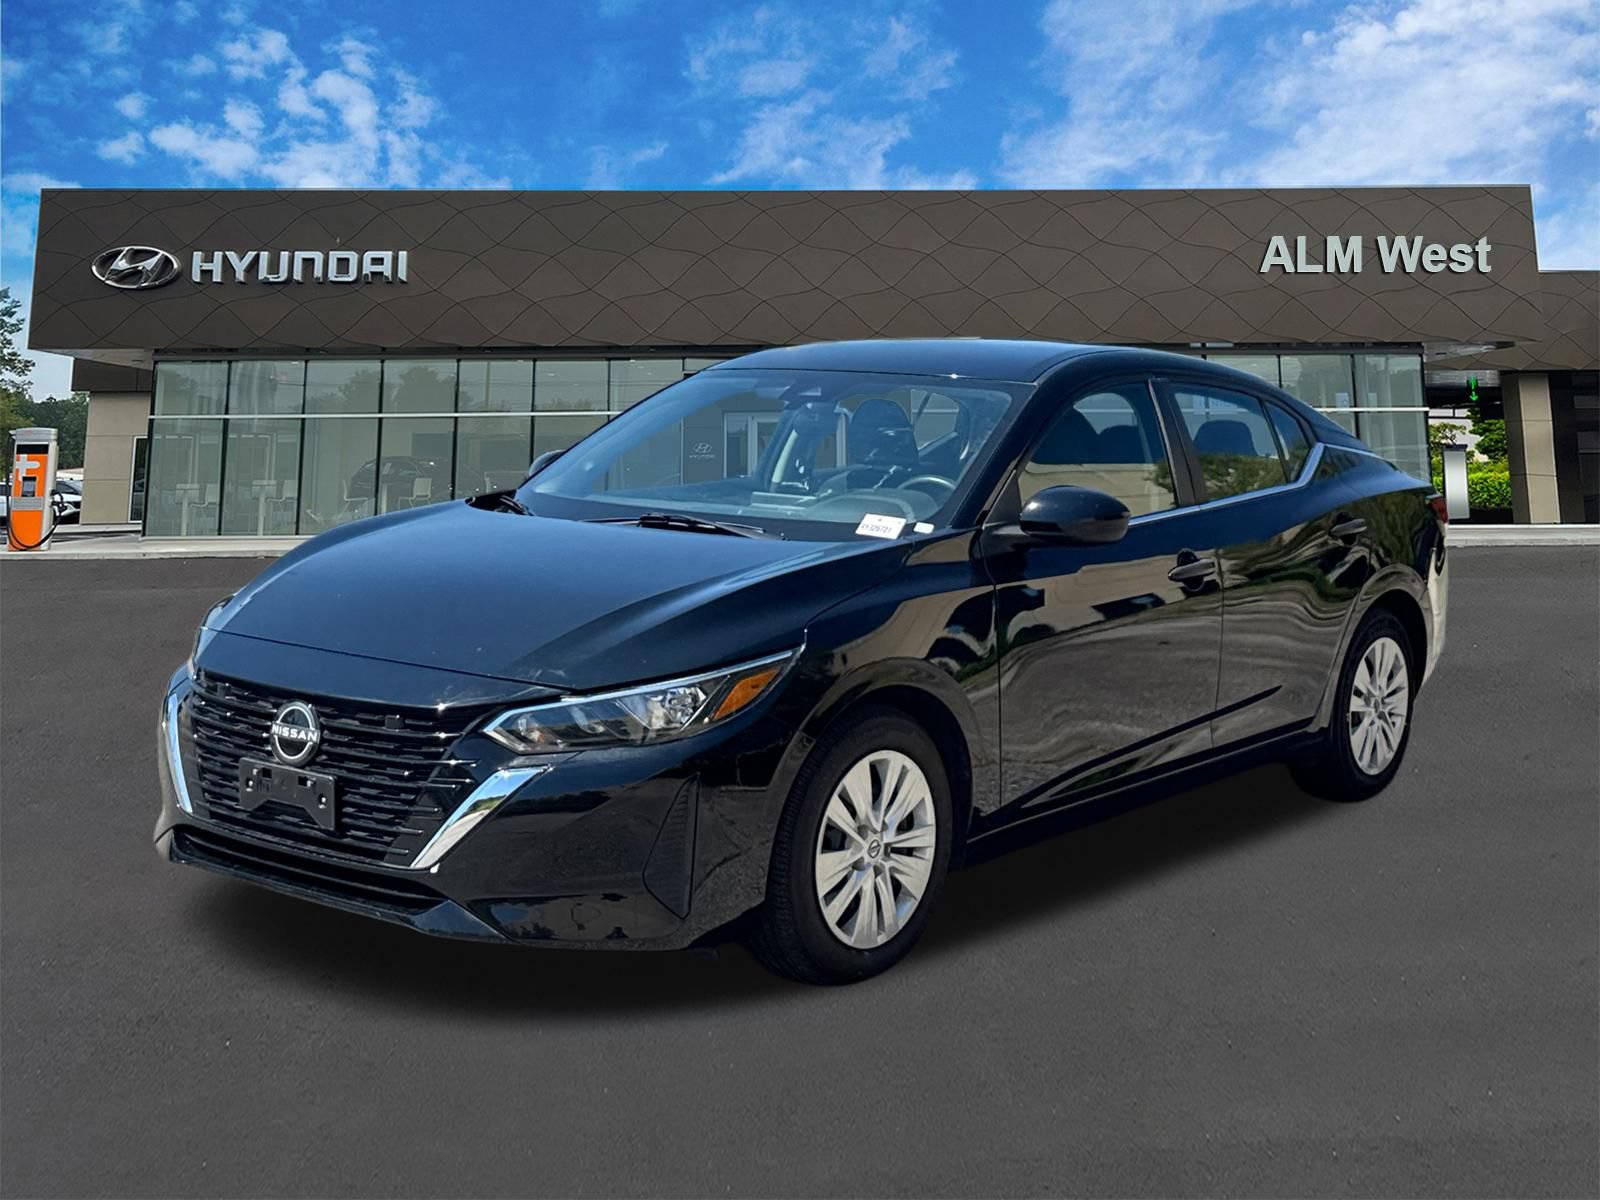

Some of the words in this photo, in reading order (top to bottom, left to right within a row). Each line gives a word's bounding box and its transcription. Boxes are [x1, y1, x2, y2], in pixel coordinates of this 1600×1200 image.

[191, 250, 408, 283] HYUNDAI
[1260, 235, 1363, 273] ALM
[1377, 235, 1492, 273] West
[271, 723, 318, 742] NISSAN
